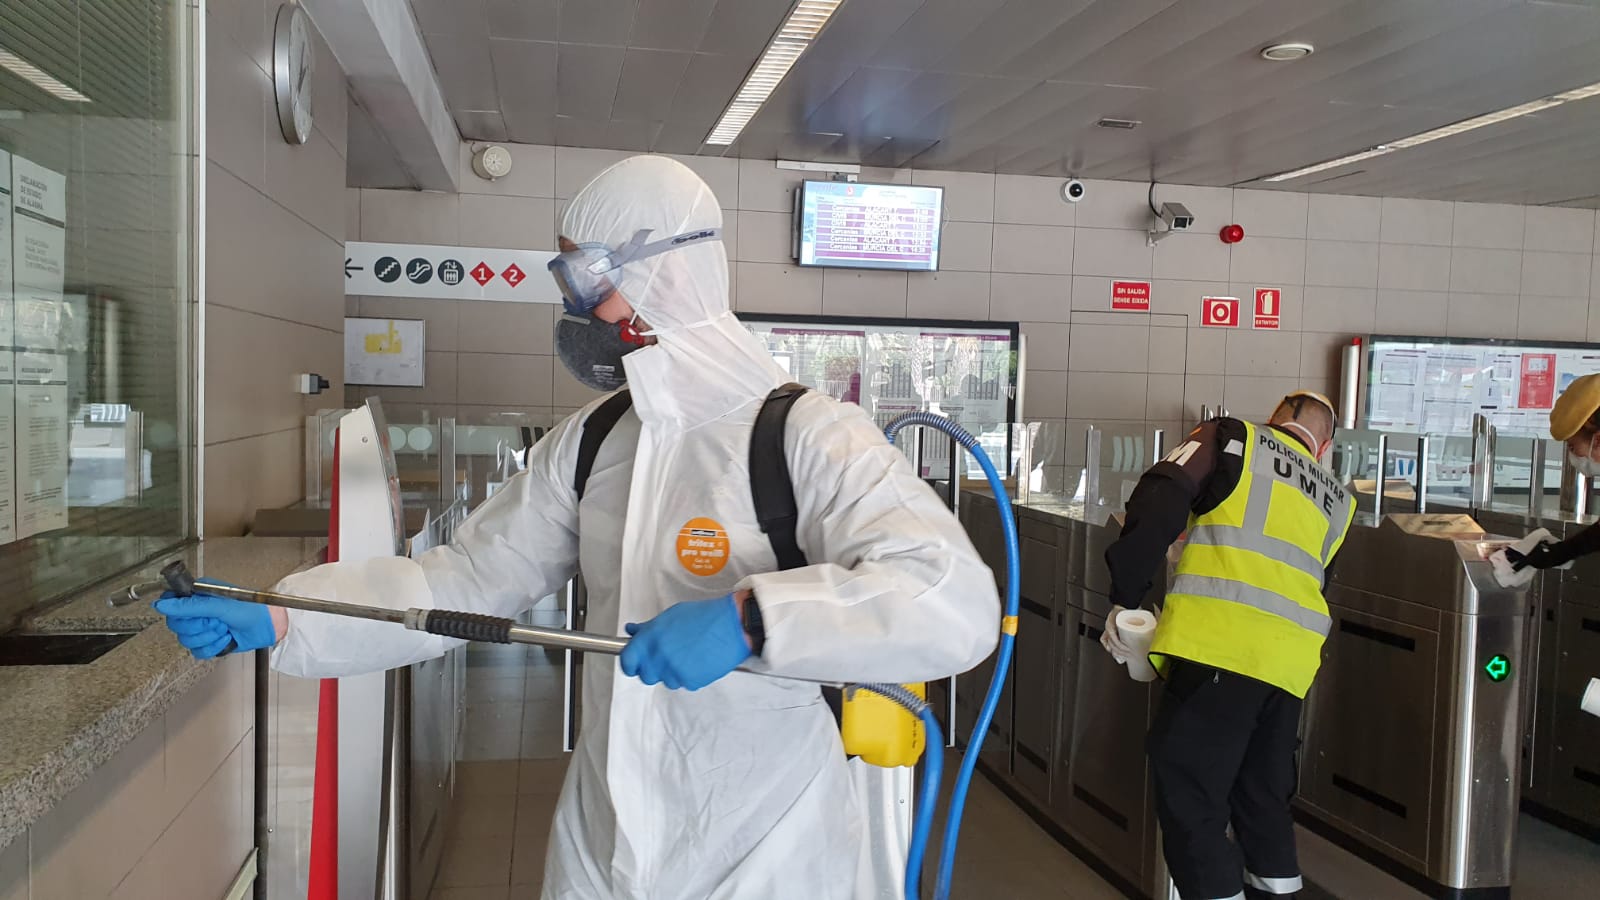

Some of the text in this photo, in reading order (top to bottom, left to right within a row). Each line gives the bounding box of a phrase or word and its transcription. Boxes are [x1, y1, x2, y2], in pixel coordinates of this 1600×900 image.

[478, 268, 518, 282] 1 2
[1260, 435, 1344, 504] POLICIA MILITAR
